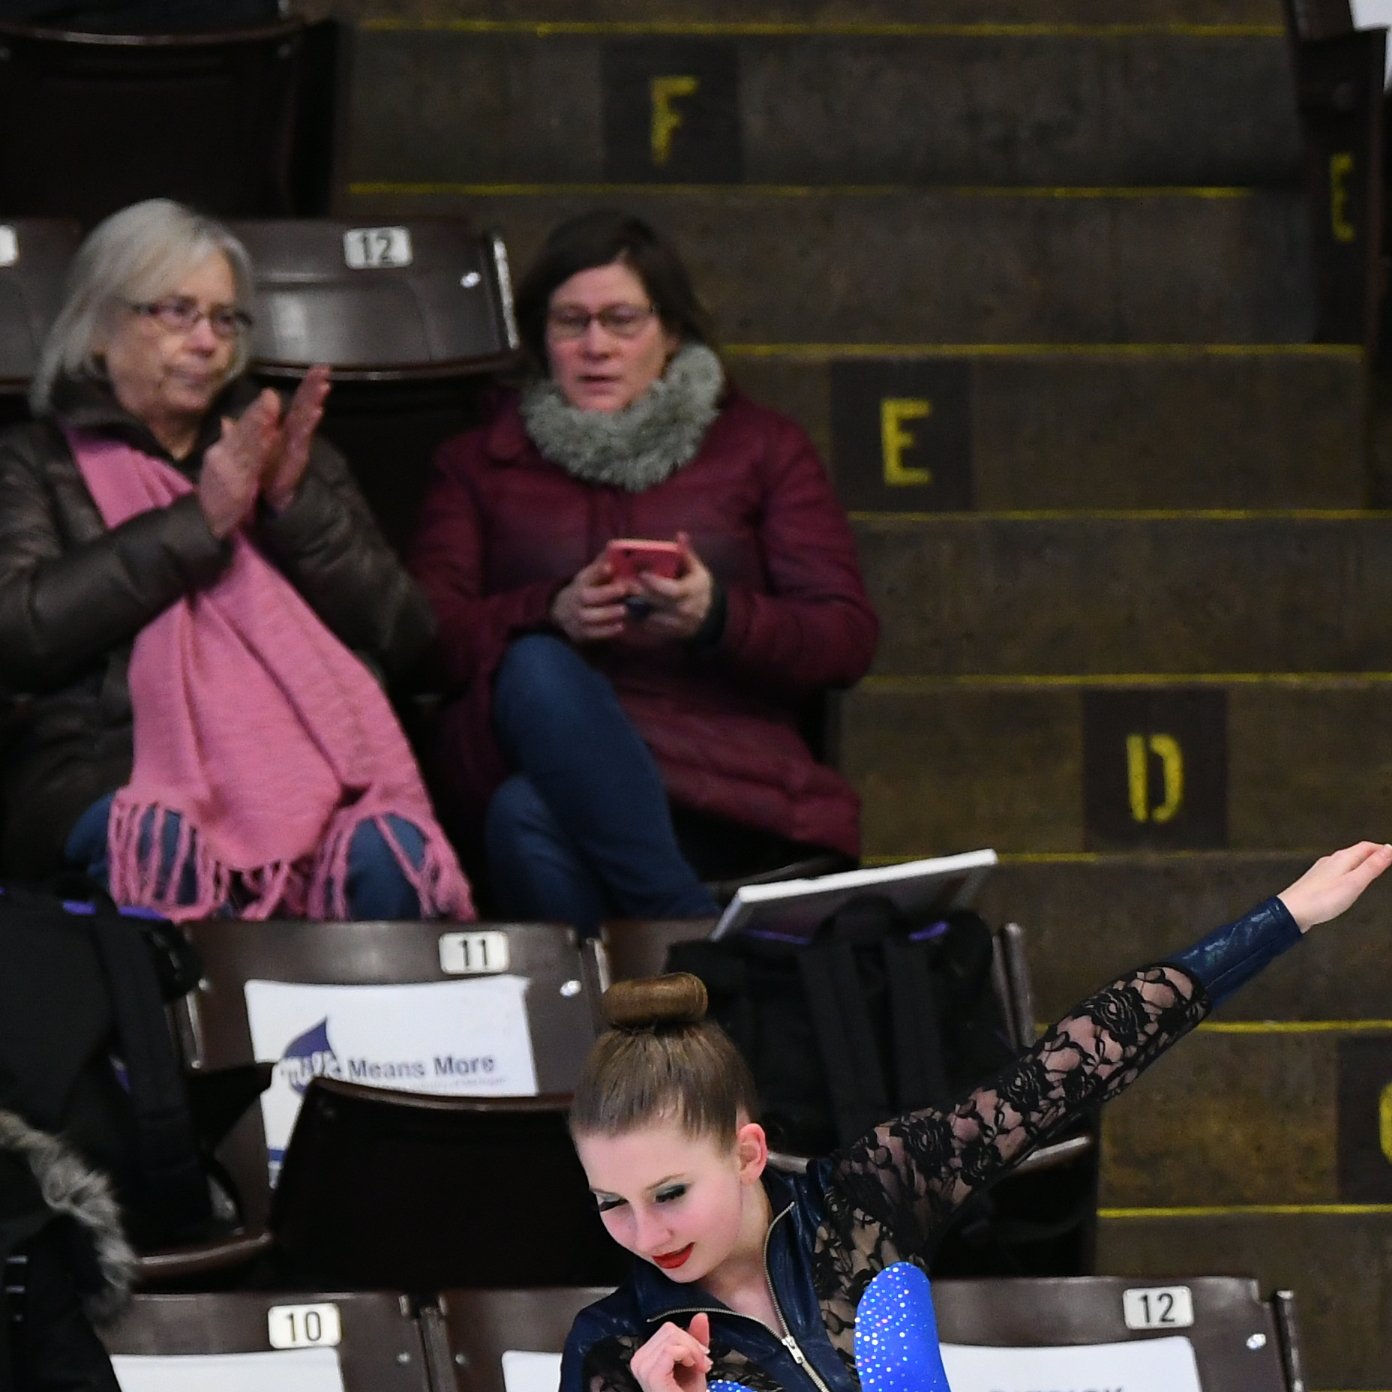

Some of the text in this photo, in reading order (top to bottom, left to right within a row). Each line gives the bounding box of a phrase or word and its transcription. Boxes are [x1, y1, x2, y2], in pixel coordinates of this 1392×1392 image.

[650, 76, 698, 165] F
[357, 232, 394, 266] 12
[880, 398, 932, 488] E
[1126, 732, 1185, 825] D
[457, 938, 491, 967] 11
[347, 1058, 426, 1079] Means
[433, 1053, 496, 1076] More
[1139, 1292, 1176, 1324] 12
[286, 1310, 323, 1343] 10
